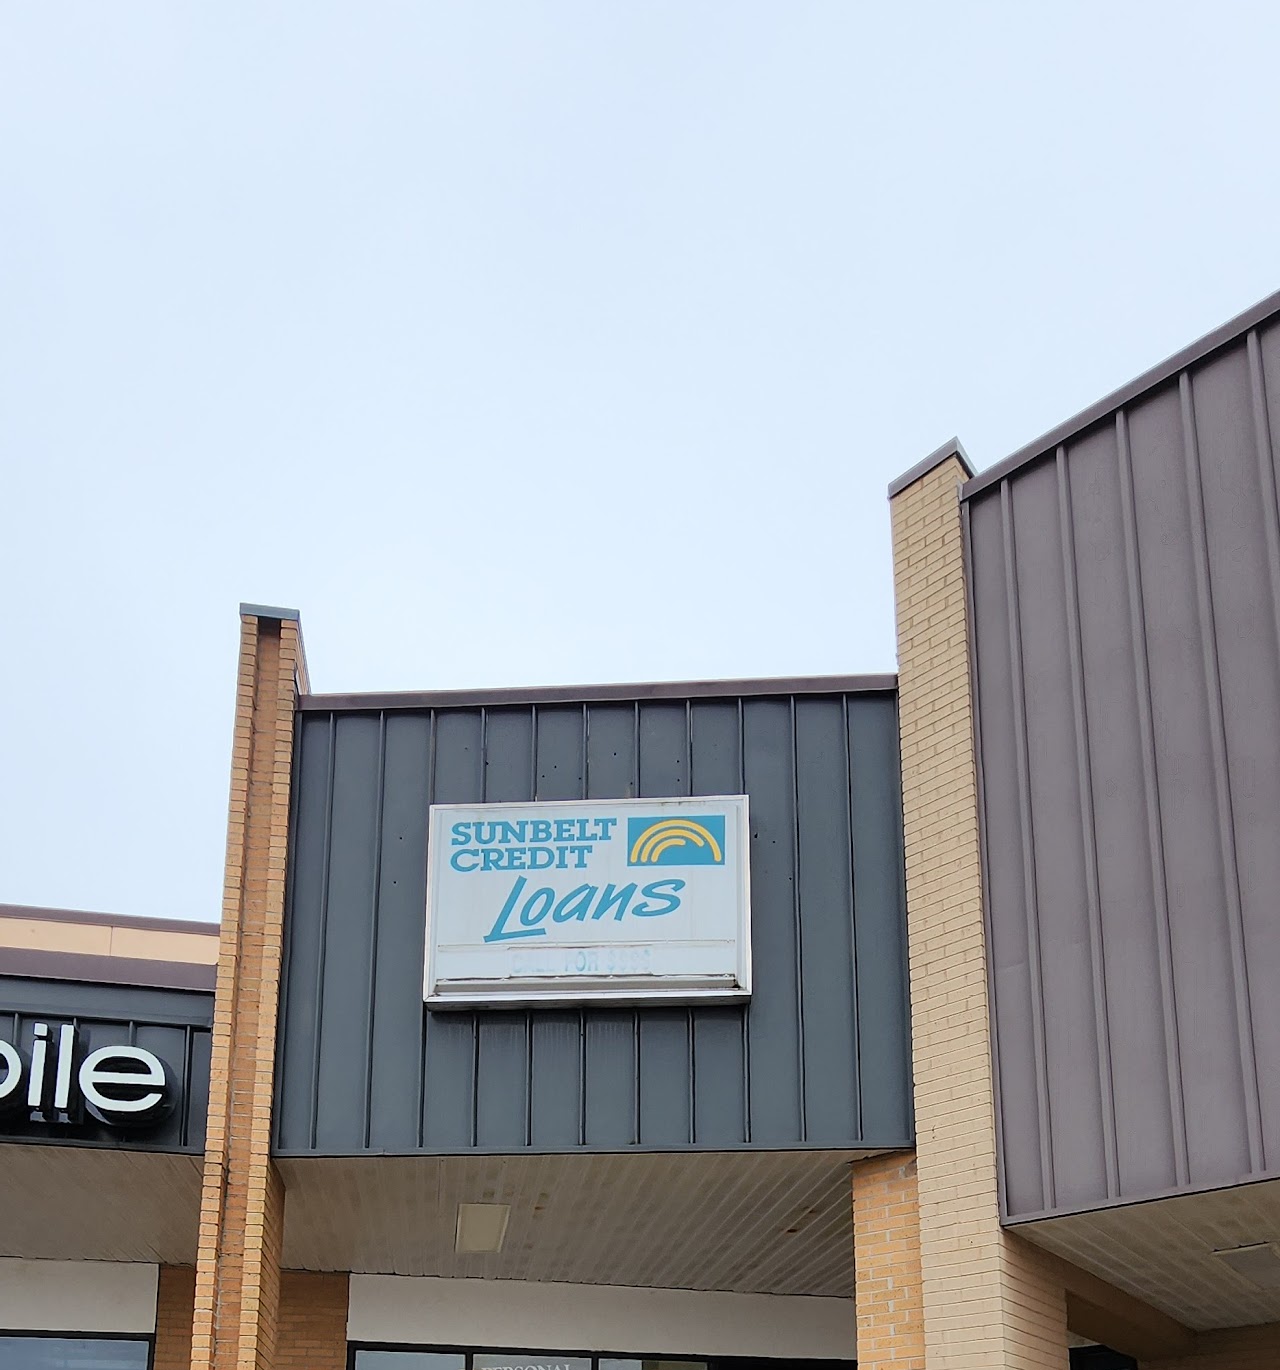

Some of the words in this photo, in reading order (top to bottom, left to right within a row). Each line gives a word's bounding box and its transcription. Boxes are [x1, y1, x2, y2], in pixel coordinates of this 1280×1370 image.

[451, 817, 617, 846] SUNBELT
[450, 845, 593, 873] CREDIT
[483, 875, 685, 943] Loans
[0, 1022, 166, 1112] ile
